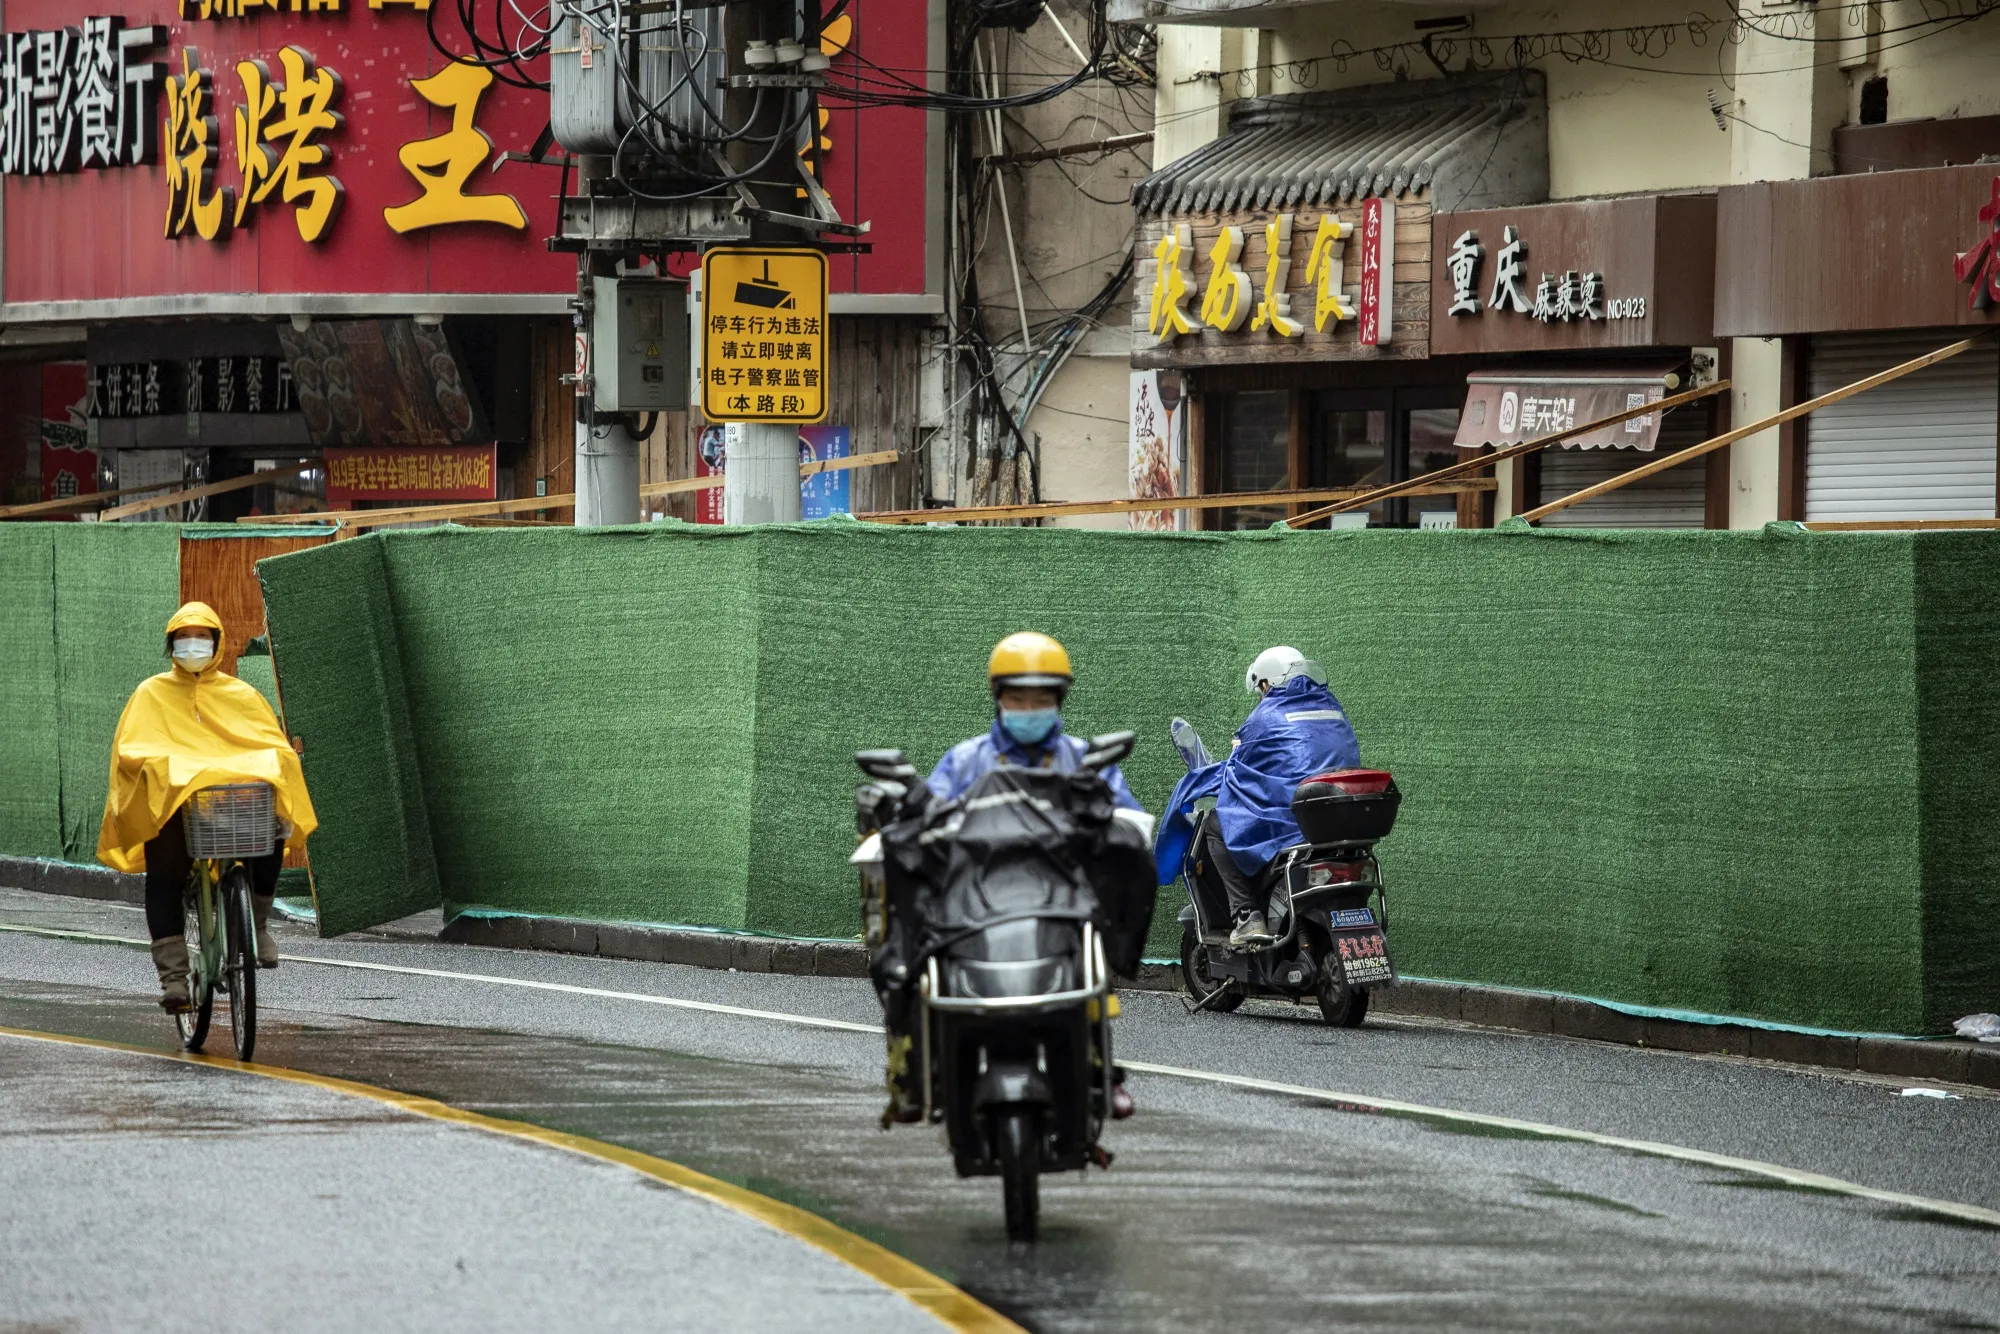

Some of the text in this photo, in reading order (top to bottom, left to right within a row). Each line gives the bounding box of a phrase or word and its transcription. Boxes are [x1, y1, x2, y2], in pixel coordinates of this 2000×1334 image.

[164, 46, 527, 242] 烧烤王
[1149, 214, 1344, 342] 陕西美食
[1447, 225, 1645, 322] 重庆 麻辣烫 NO:023
[711, 315, 820, 335] 停车行为违法
[722, 341, 812, 360] 请立即驶离
[88, 364, 160, 417] 大饼油条
[188, 358, 292, 412] 浙影餐厅
[711, 367, 819, 387] 电子警察监管
[1520, 397, 1568, 432] 摩天轮
[1343, 956, 1389, 971] 始创1962年
